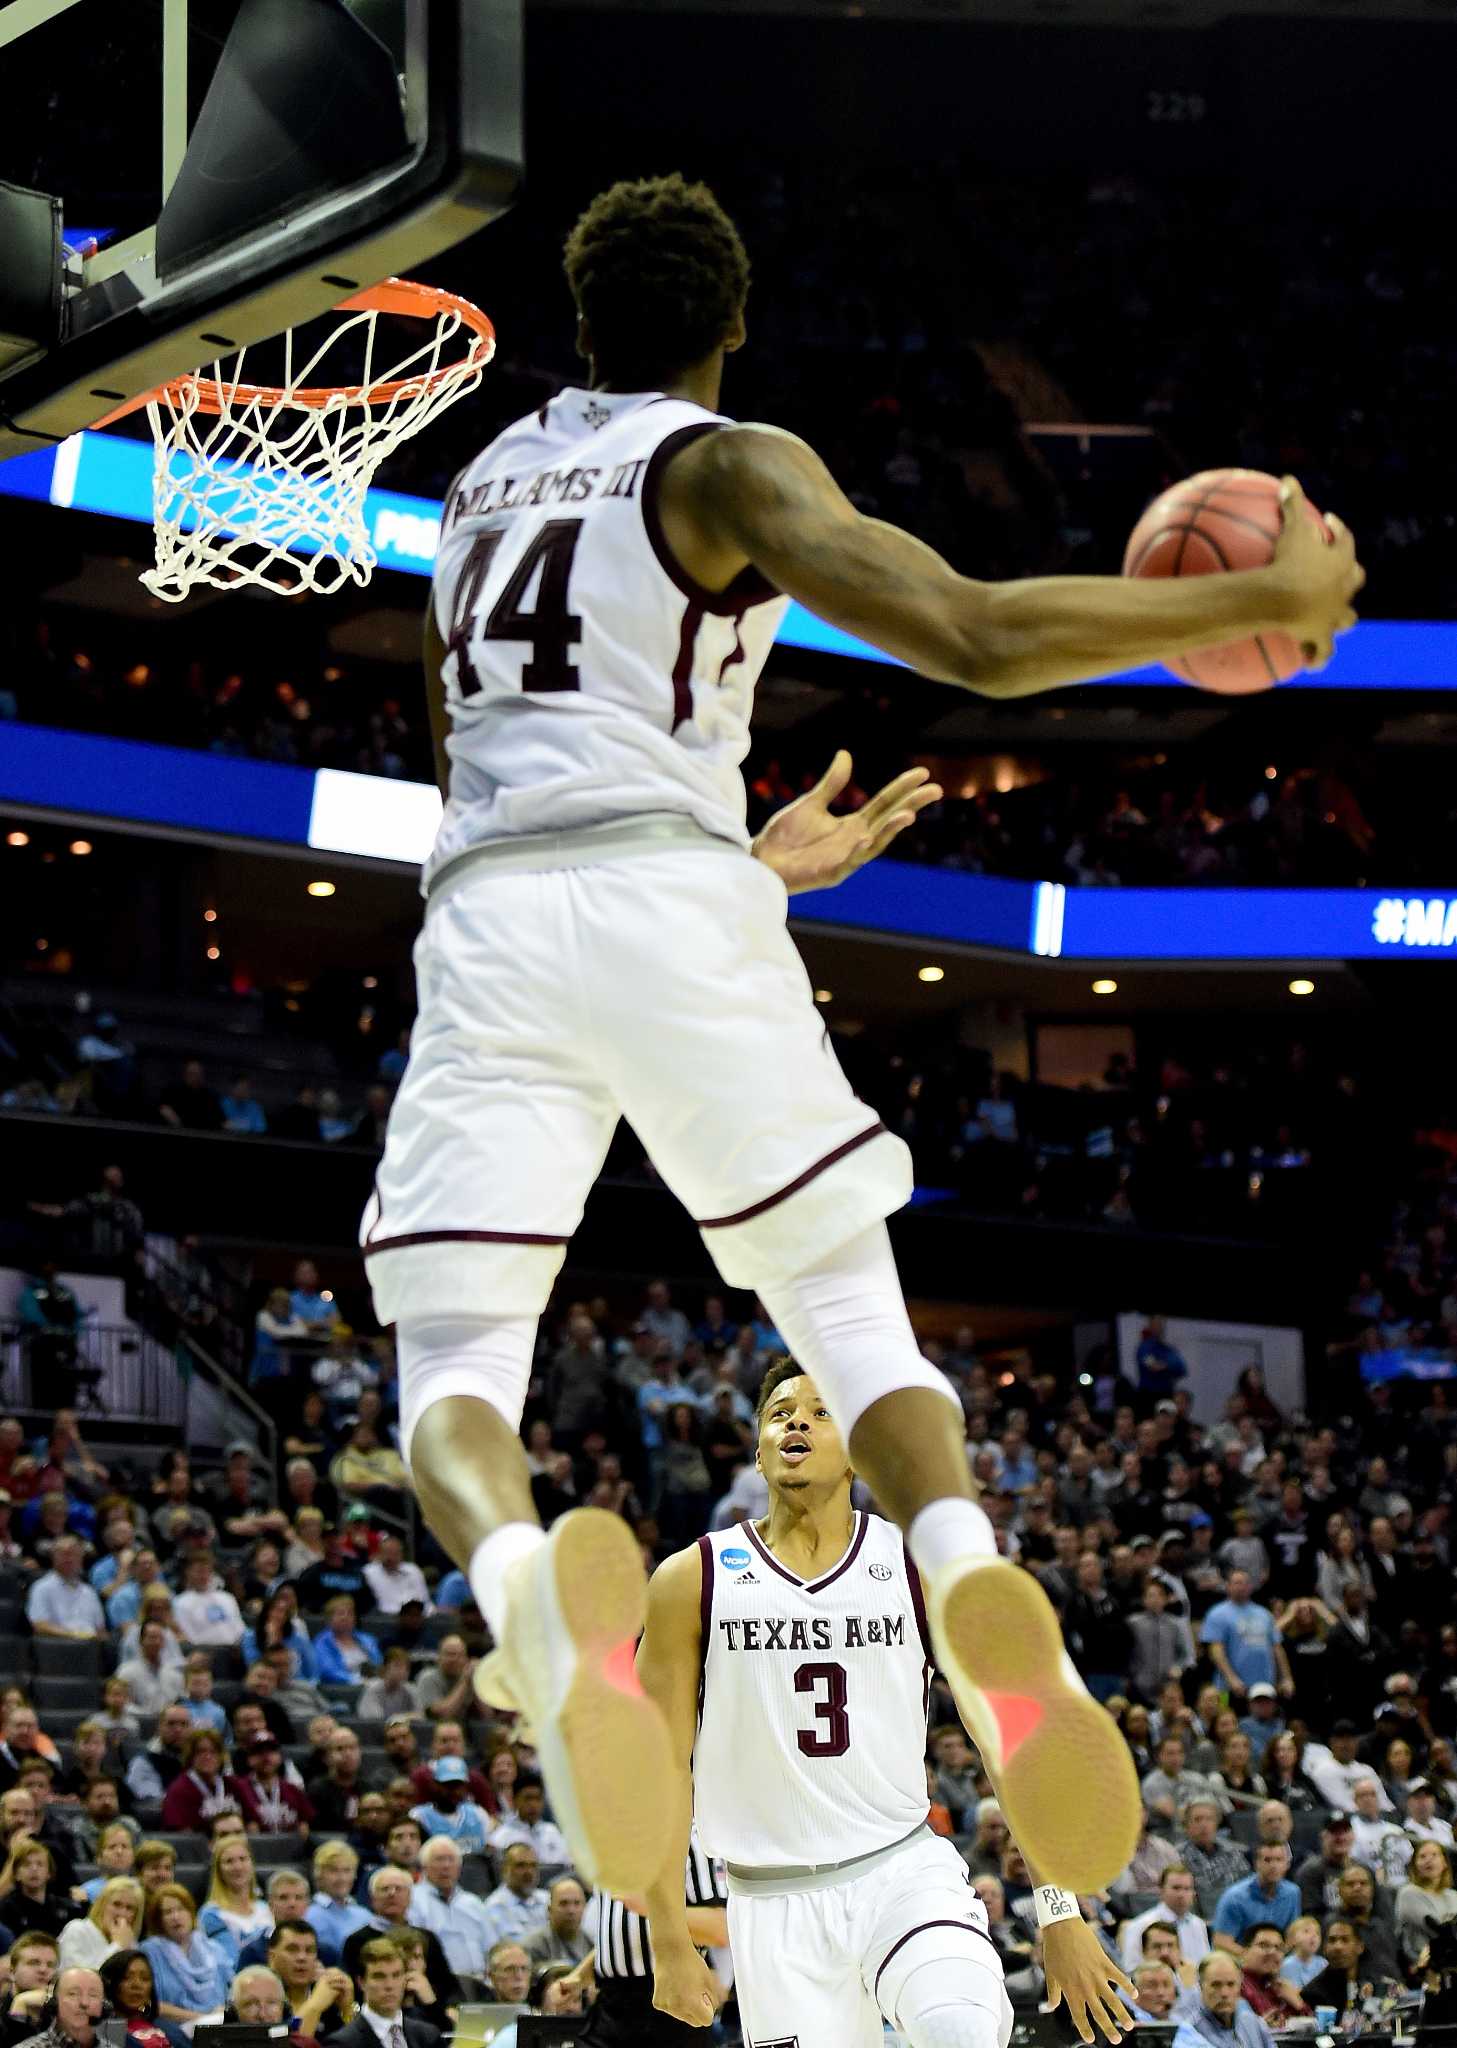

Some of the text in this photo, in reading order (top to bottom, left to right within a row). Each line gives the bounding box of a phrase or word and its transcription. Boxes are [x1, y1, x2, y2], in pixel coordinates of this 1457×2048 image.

[448, 518, 585, 698] 44
[720, 1614, 906, 1650] TEXAS A&M
[793, 1662, 850, 1757] 3
